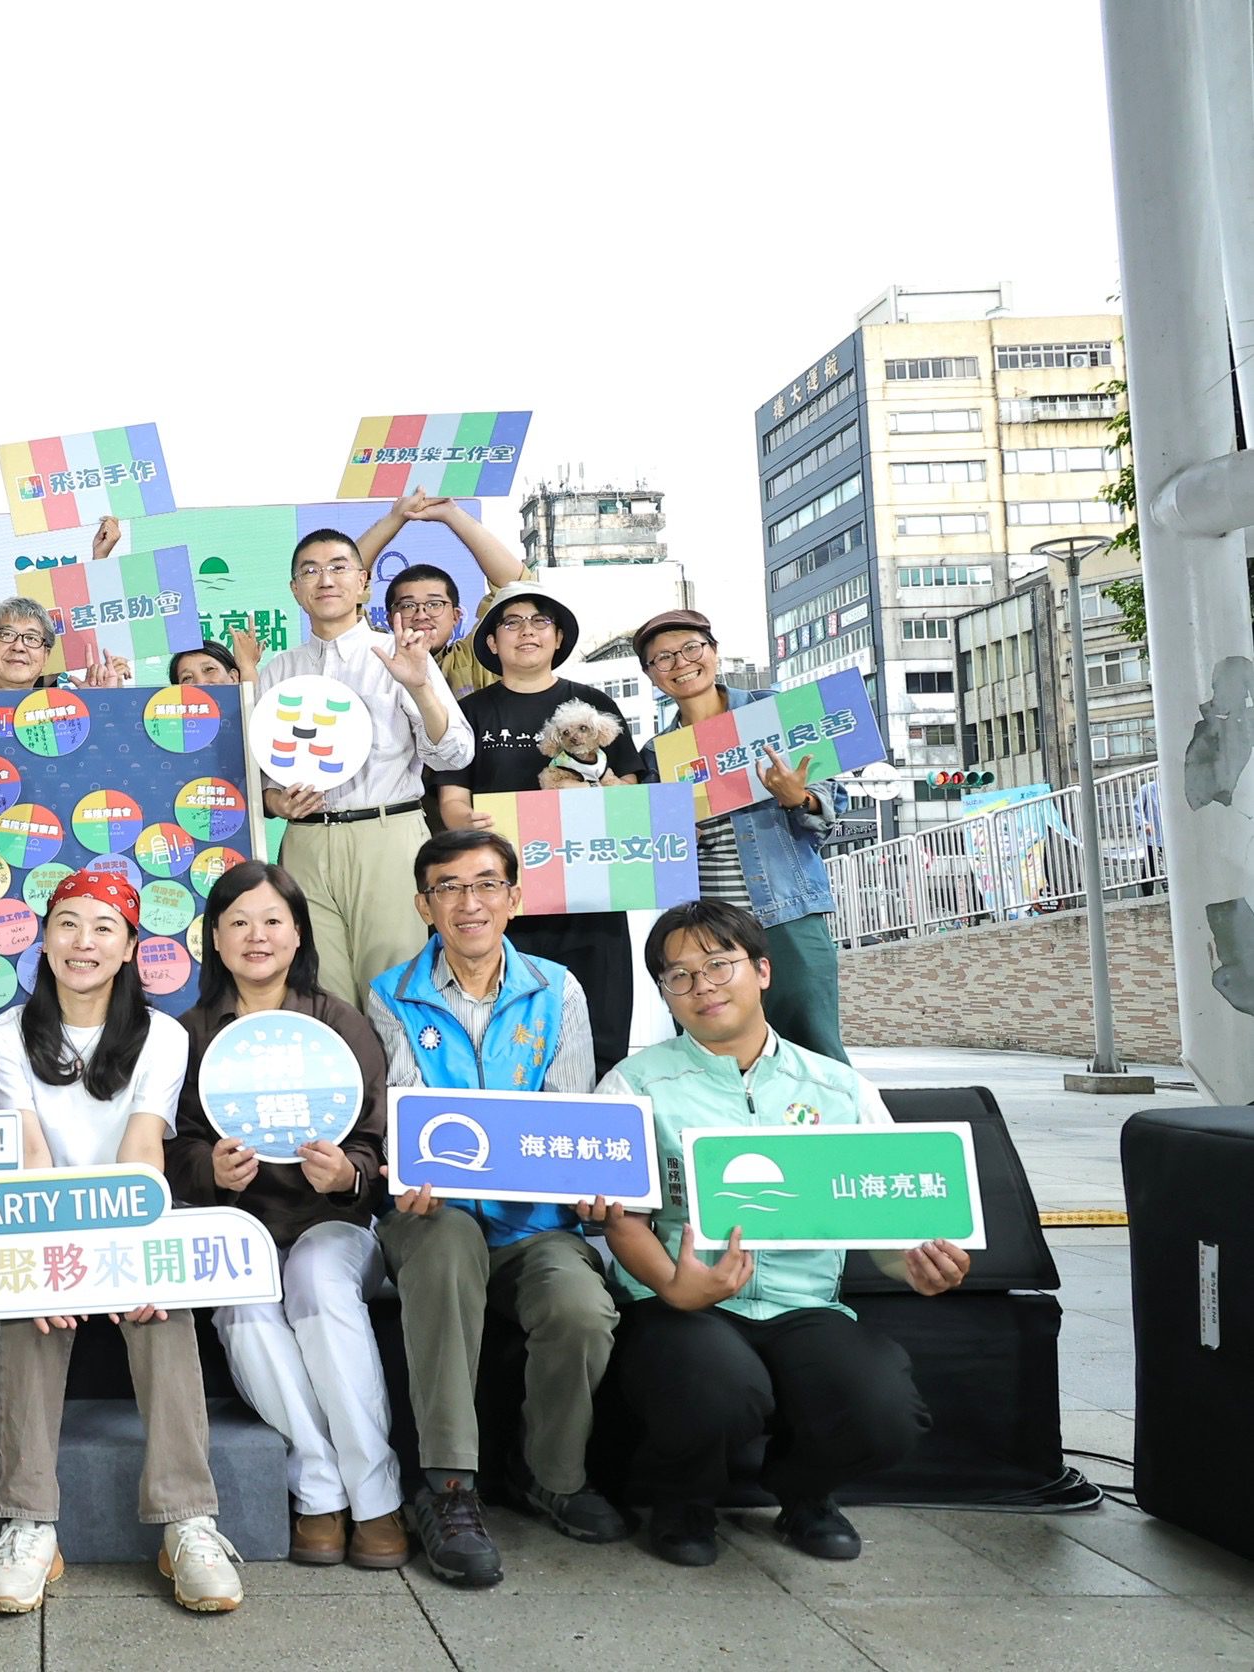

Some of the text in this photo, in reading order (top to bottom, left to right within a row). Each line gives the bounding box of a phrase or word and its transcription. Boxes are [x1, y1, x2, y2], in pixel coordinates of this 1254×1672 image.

[374, 444, 515, 464] 媽媽樂工作室
[50, 461, 155, 494] 飛海手作
[71, 591, 182, 630] 基原助會
[524, 834, 687, 868] 多卡思文化
[519, 1134, 633, 1162] 海港航城
[69, 1185, 149, 1221] TIME
[831, 1173, 948, 1200] 山海亮點
